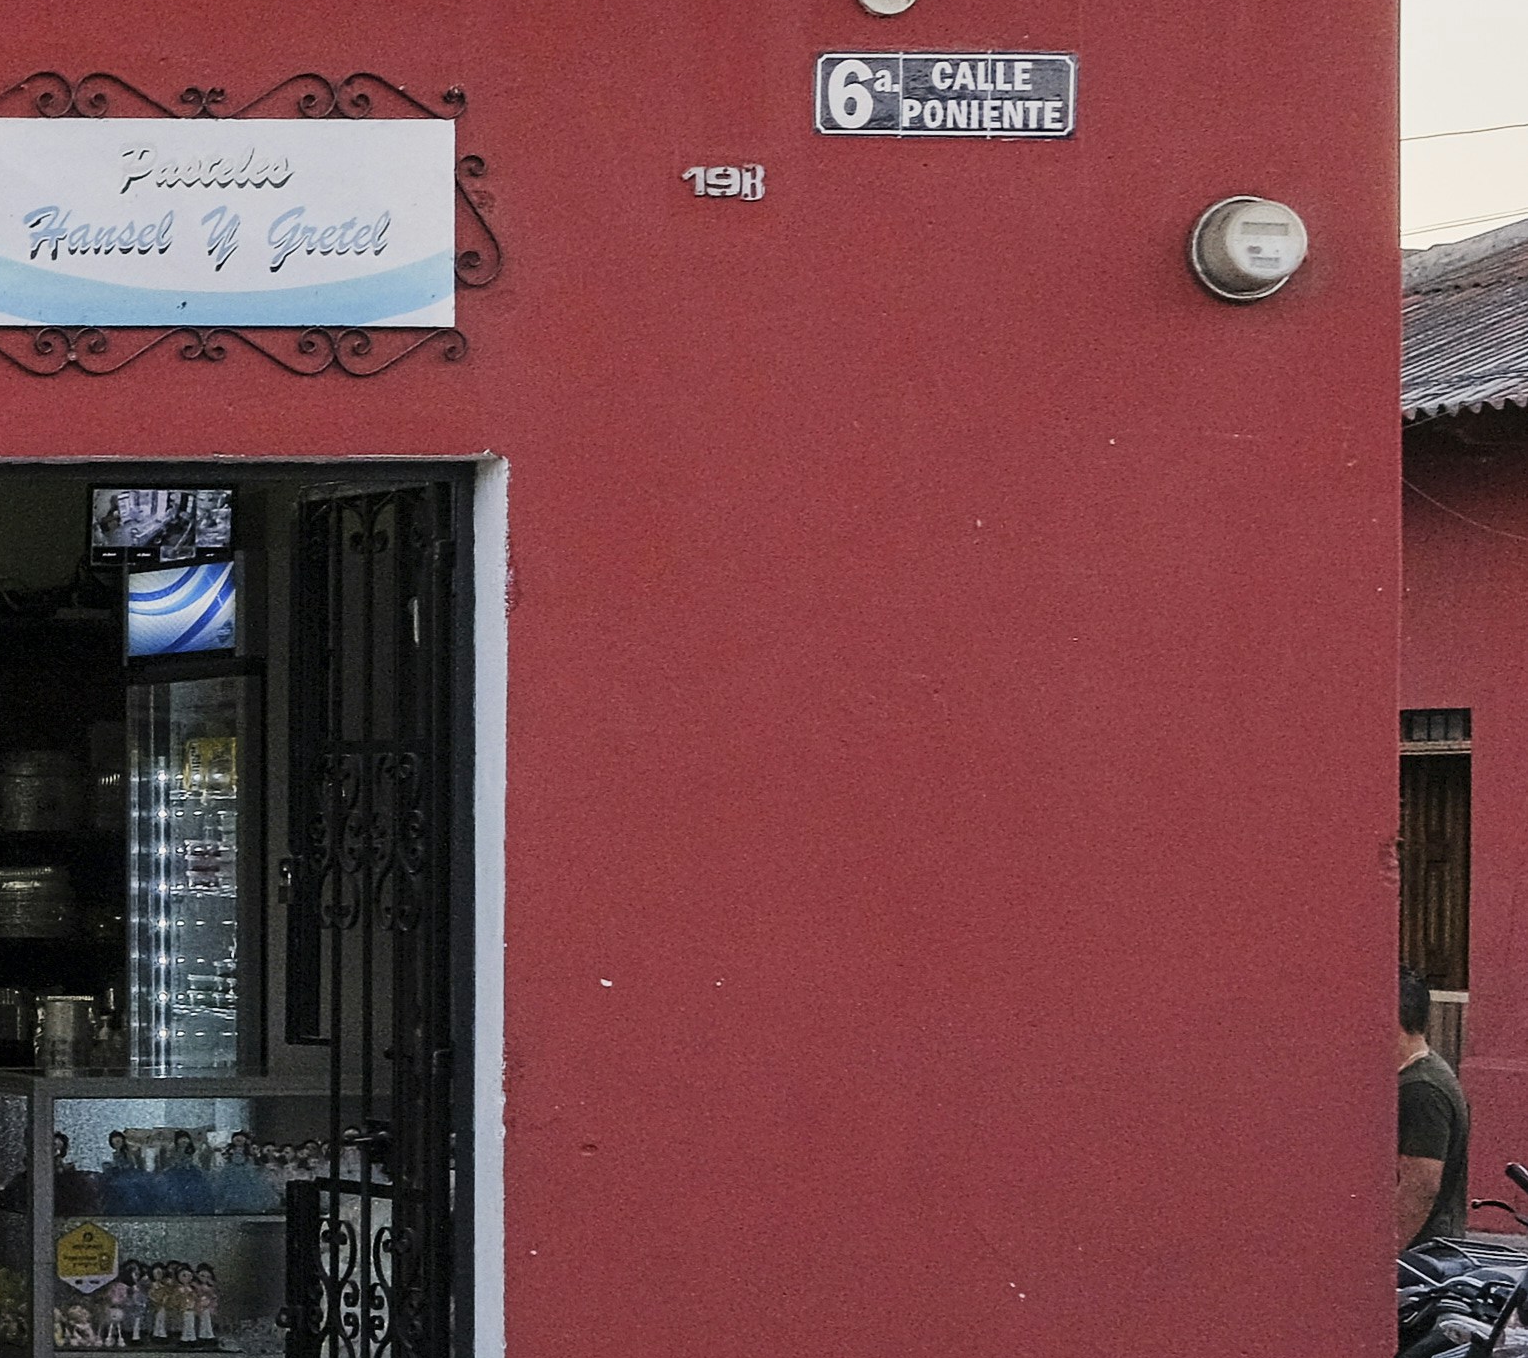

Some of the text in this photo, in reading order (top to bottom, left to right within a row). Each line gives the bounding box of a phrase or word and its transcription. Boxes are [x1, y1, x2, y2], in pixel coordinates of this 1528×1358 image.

[827, 59, 1033, 129] 6a. CALLE
[902, 98, 1064, 129] PONIENTE
[117, 141, 295, 194] Pasteles
[23, 205, 392, 273] Hansel Y Gretel
